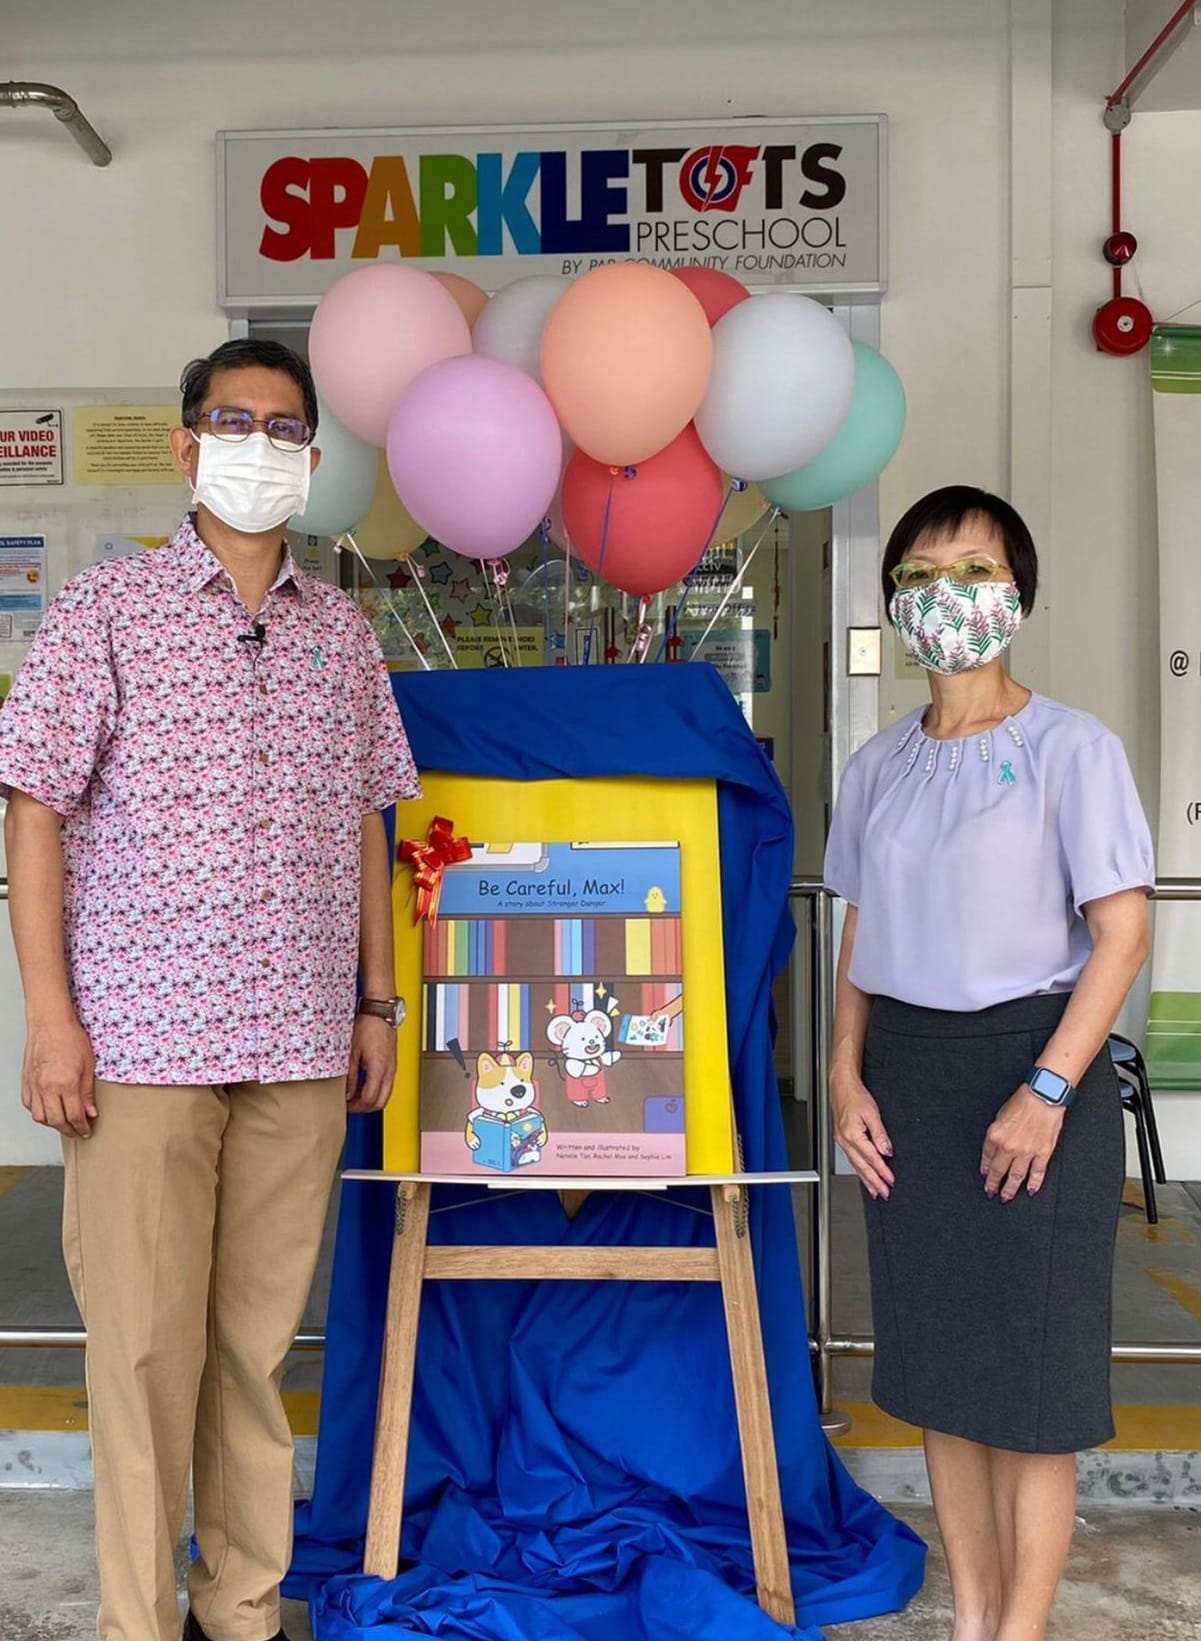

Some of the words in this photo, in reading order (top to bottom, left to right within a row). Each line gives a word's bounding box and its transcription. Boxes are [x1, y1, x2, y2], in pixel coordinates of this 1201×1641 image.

[637, 216, 846, 252] PRESCHOOL
[561, 259, 583, 275] BY
[735, 253, 847, 271] FOUNDATION
[18, 430, 54, 442] VIDEO
[1169, 650, 1189, 677] @
[478, 879, 500, 896] Be
[506, 879, 577, 898] Careful,
[583, 878, 625, 896] Max!
[547, 900, 578, 908] Stranger
